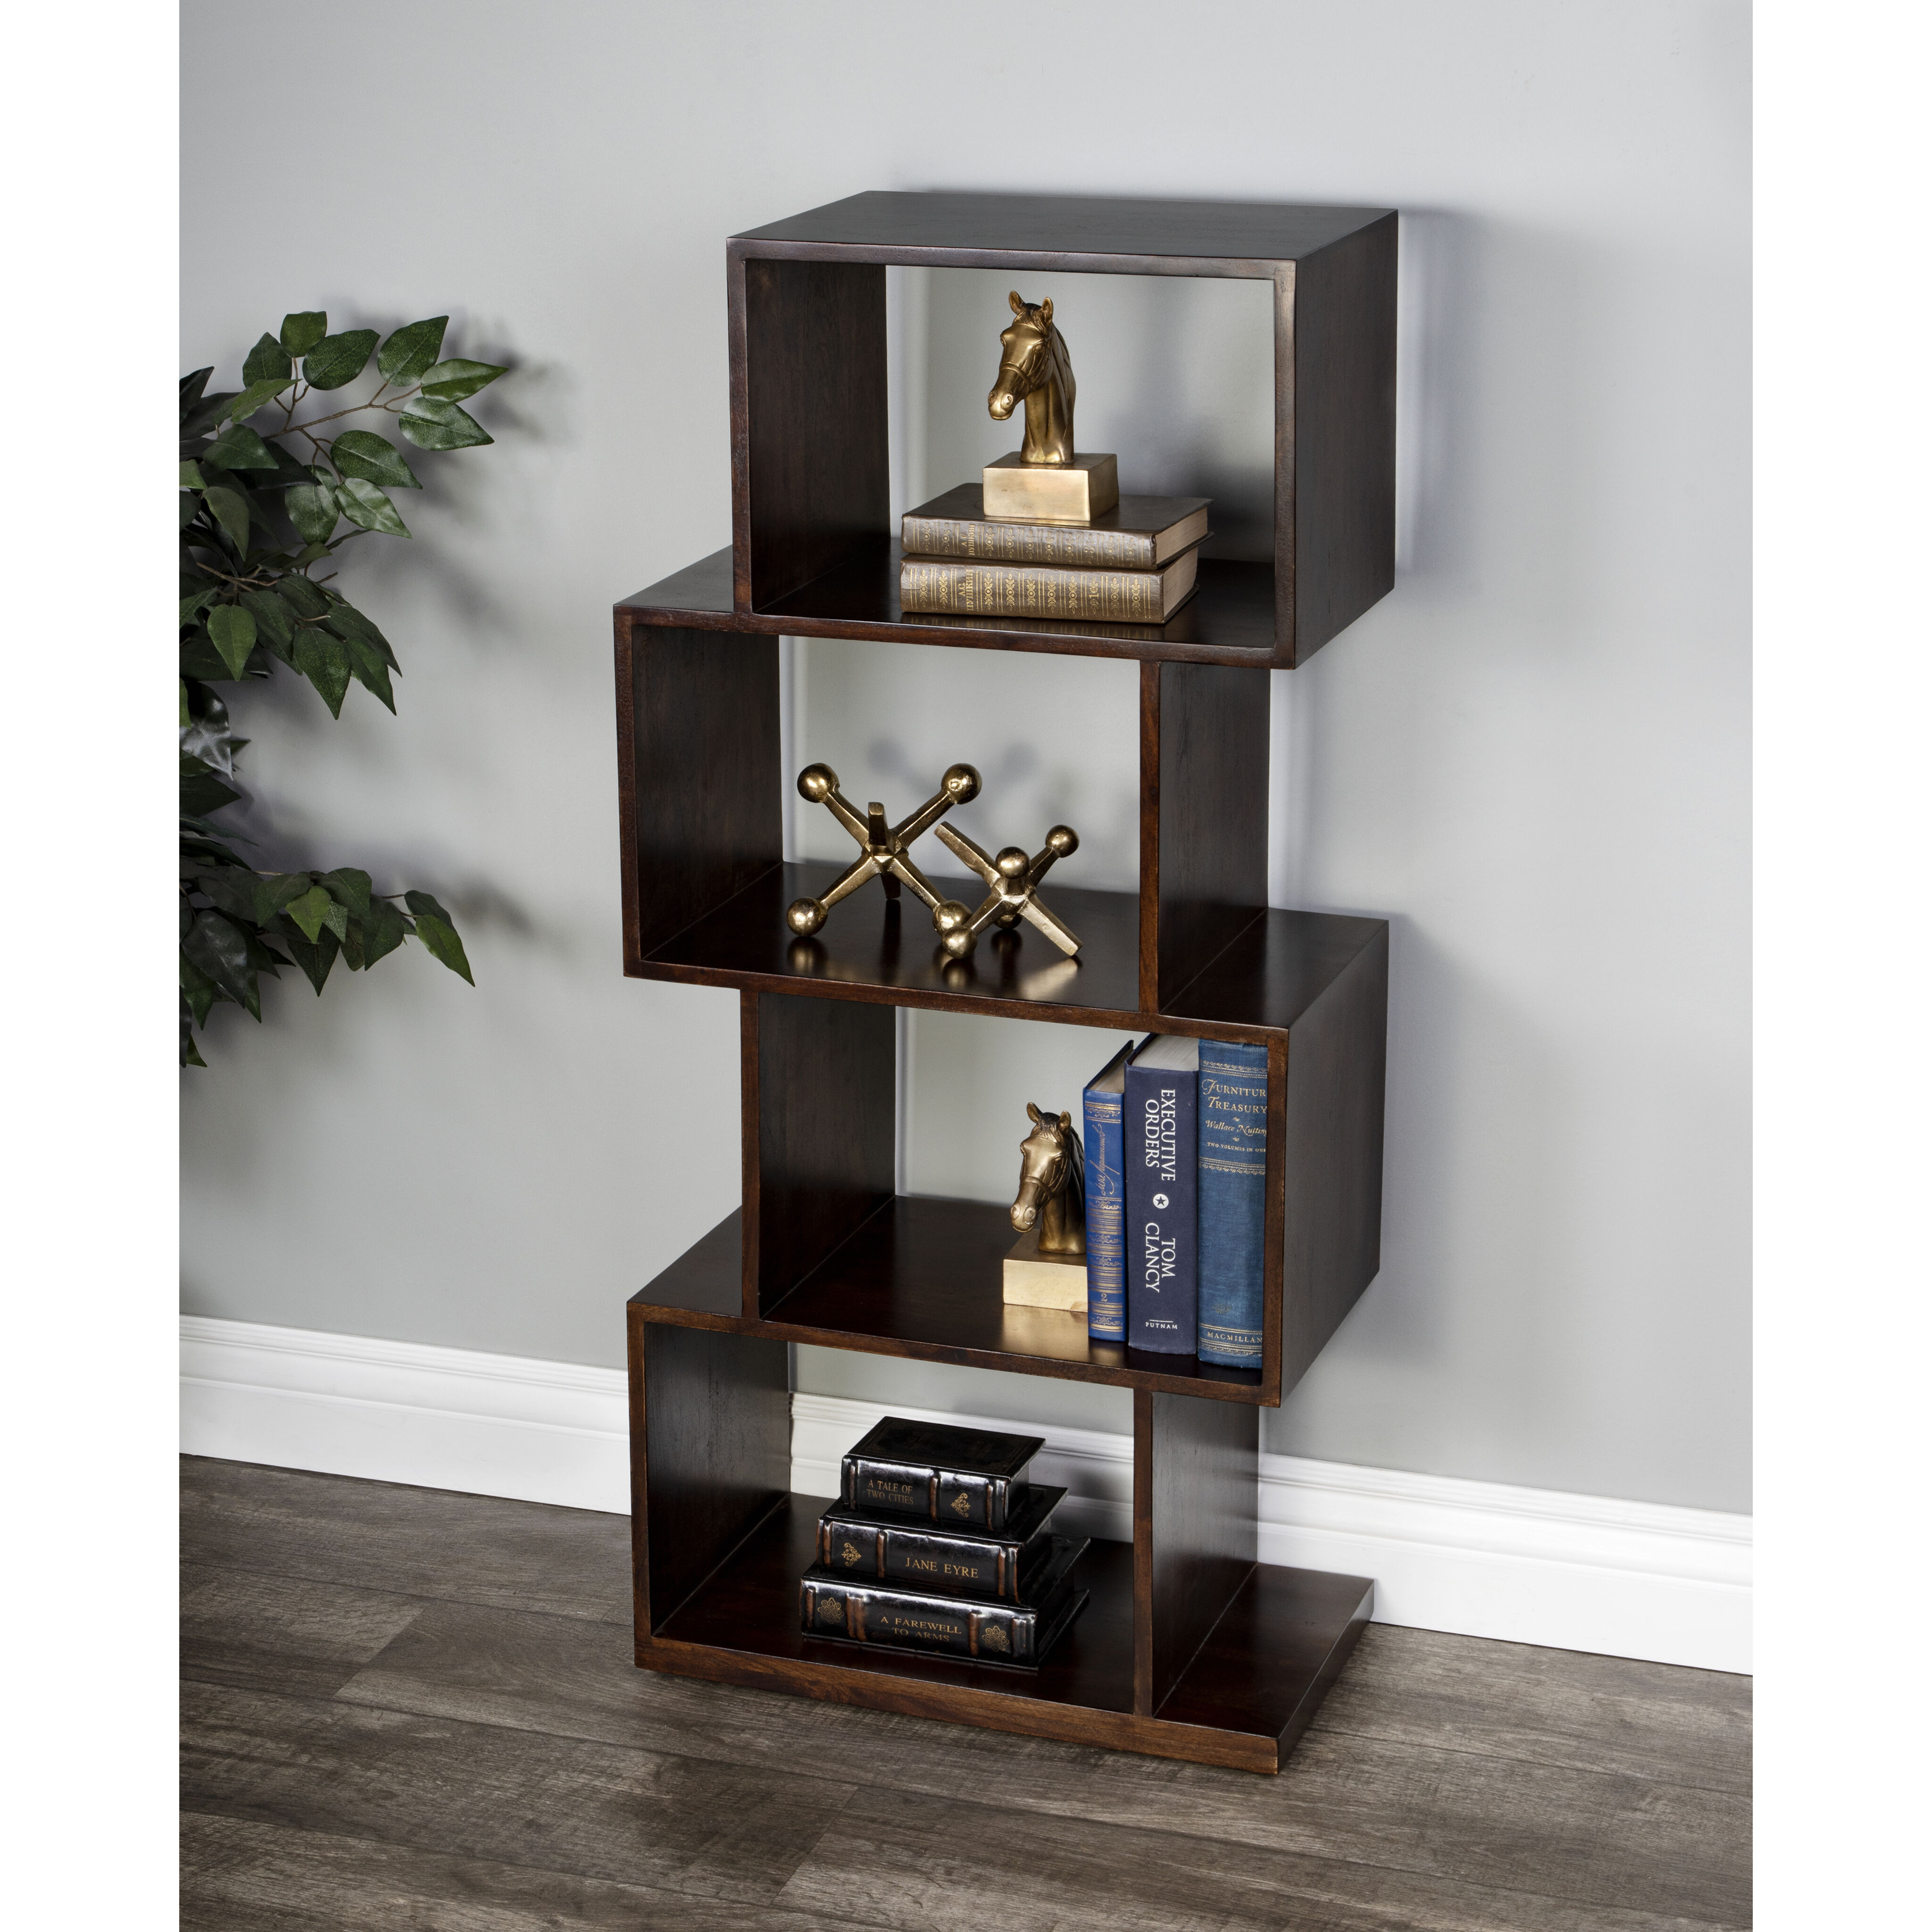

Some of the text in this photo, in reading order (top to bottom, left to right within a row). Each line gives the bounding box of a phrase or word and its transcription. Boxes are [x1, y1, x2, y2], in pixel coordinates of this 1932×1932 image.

[966, 569, 974, 611] ПУШКИН
[1201, 1079, 1266, 1097] FURNITUR
[1208, 1096, 1267, 1114] TREASURY
[1145, 1099, 1160, 1168] ORDERS
[1161, 1089, 1176, 1181] EXECUTIVE
[1205, 1120, 1235, 1132] Wallace
[1145, 1222, 1160, 1293] CLANCY
[1161, 1238, 1176, 1278] TOM
[1101, 1293, 1108, 1302] 2
[1145, 1322, 1178, 1330] PUTNAM
[1207, 1331, 1263, 1343] MACMILLAN
[868, 1479, 913, 1495] A TALE OF
[866, 1489, 914, 1505] TWO CITIES
[905, 1557, 979, 1579] JANE EYRE
[880, 1616, 962, 1634] A FAREWELL
[892, 1627, 950, 1642] TO ARMS
